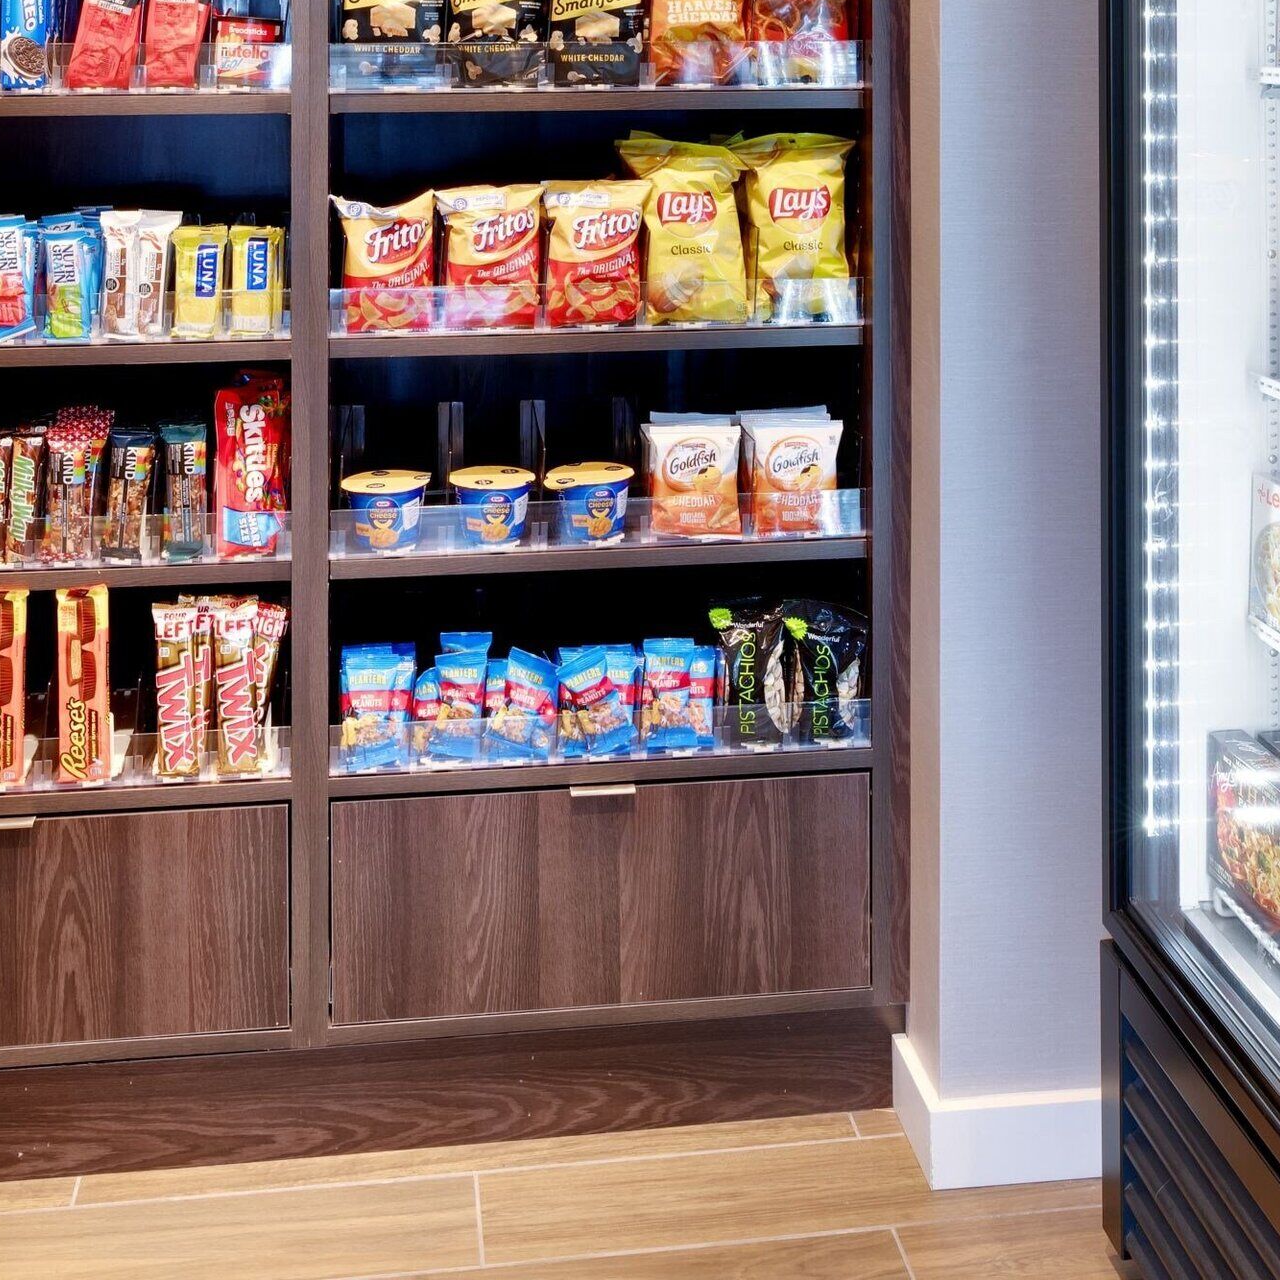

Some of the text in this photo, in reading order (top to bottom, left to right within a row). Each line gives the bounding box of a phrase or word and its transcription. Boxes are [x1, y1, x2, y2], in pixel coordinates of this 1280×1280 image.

[667, 11, 737, 24] CHEDDAR
[229, 24, 268, 37] Breadsticks
[220, 45, 269, 61] nutella
[354, 44, 420, 54] WHITE CHEDDAR
[483, 43, 521, 53] CHEDDAR
[560, 53, 625, 62] WHITE CHEDDAR
[662, 192, 714, 224] Lay's
[774, 185, 829, 222] Lay's
[364, 219, 429, 263] Fritos
[472, 209, 535, 253] Fritos
[572, 209, 640, 250] Fritos
[671, 244, 712, 256] Classic
[783, 239, 824, 252] Classic
[197, 248, 216, 294] LUNA
[251, 239, 268, 286] LUNA
[476, 250, 536, 278] The ORIGINAL
[592, 250, 635, 276] ORIGINAL
[125, 447, 136, 480] KIND
[184, 442, 195, 474] KIND
[239, 404, 265, 504] Skittles
[670, 448, 716, 475] Goldfish
[772, 448, 820, 473] Goldfish
[672, 495, 716, 507] CHEDDAR
[775, 495, 819, 507] CHEDDAR
[155, 620, 194, 639] LEFT
[807, 633, 841, 643] Wonderful
[349, 674, 387, 685] PLANTERS
[441, 668, 478, 679] PLANTERS
[652, 678, 680, 688] PEANUTS
[739, 632, 756, 734] PISTACHIOS
[352, 698, 382, 707] PEANUTS
[447, 688, 476, 699] PEANUTS
[813, 645, 831, 735] PISTACHIOS
[156, 653, 195, 770] TWIX
[217, 648, 257, 765] TWIX
[61, 696, 86, 779] Reese's
